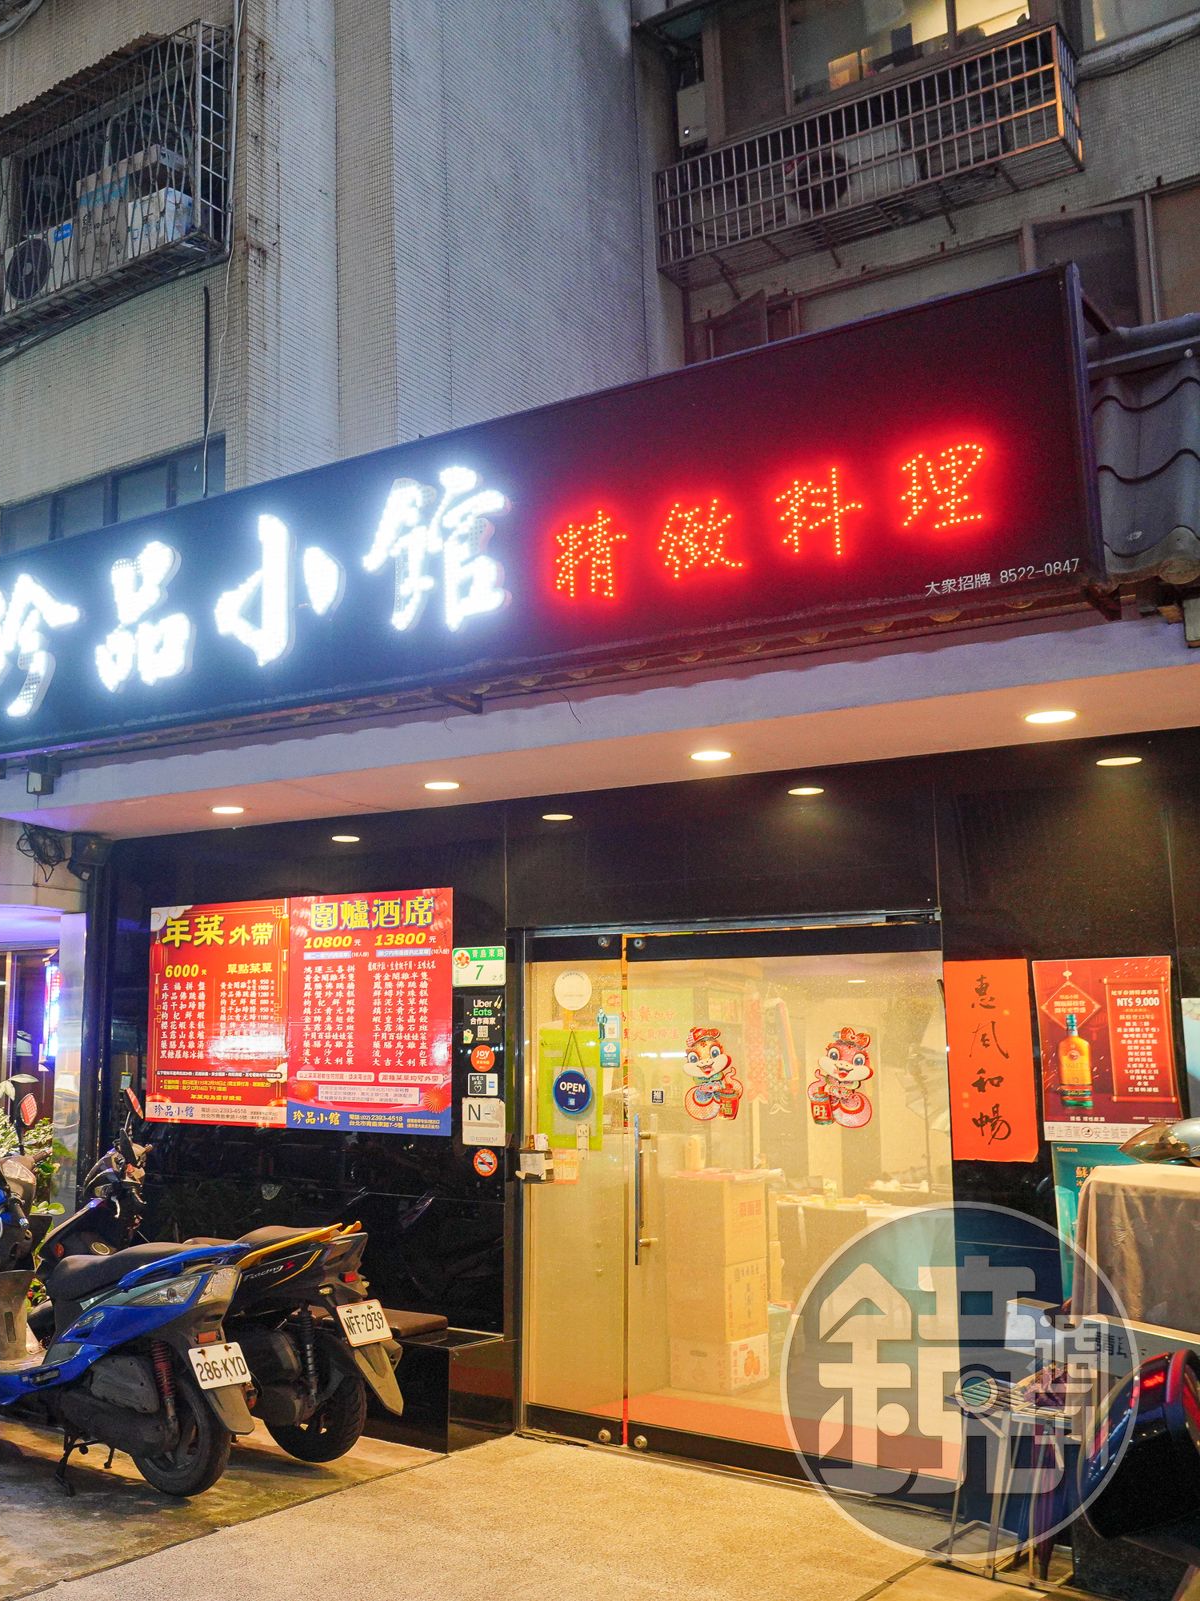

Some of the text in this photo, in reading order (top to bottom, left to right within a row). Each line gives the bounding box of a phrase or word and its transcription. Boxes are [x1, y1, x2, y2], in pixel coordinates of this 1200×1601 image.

[999, 557, 1081, 584] 8522-0847
[309, 895, 436, 933] 圍爐酒席
[303, 935, 353, 949] 10800
[374, 932, 427, 946] 13800
[165, 964, 199, 978] 6000
[476, 965, 484, 980] 7
[473, 999, 492, 1008] Uber
[1116, 997, 1160, 1007] NT$ 9,000
[473, 1008, 493, 1016] Eats
[559, 1081, 586, 1093] OPEN
[154, 1105, 195, 1118] 珍品小館
[293, 1110, 341, 1126] 珍品小館
[343, 1311, 384, 1335] NFF-2939
[196, 1355, 248, 1382] 286-KYD
